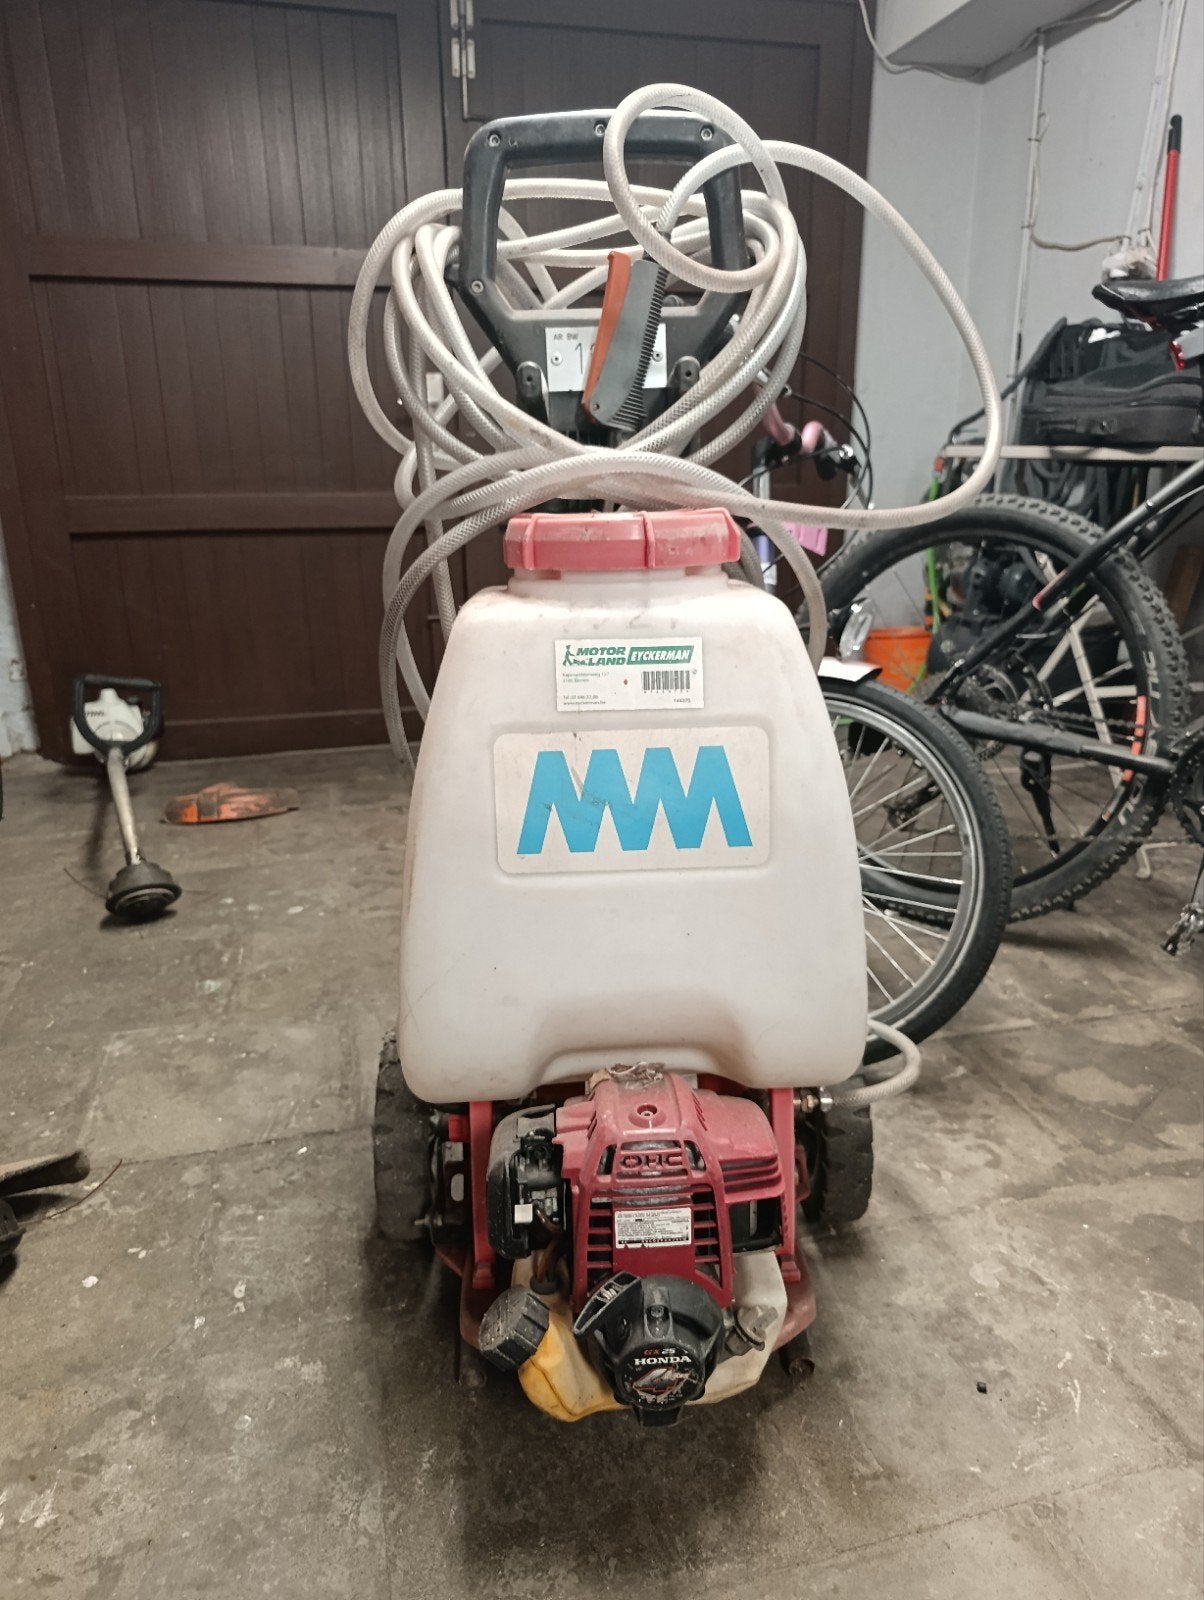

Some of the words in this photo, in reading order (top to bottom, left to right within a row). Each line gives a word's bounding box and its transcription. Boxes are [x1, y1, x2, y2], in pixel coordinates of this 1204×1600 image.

[553, 333, 563, 341] AR
[576, 646, 627, 656] MOTOR
[630, 649, 691, 662] EYCKERMAN
[587, 657, 626, 666] LAND
[620, 1152, 683, 1169] OHC
[661, 1347, 676, 1355] 25
[634, 1355, 692, 1366] HONDA
